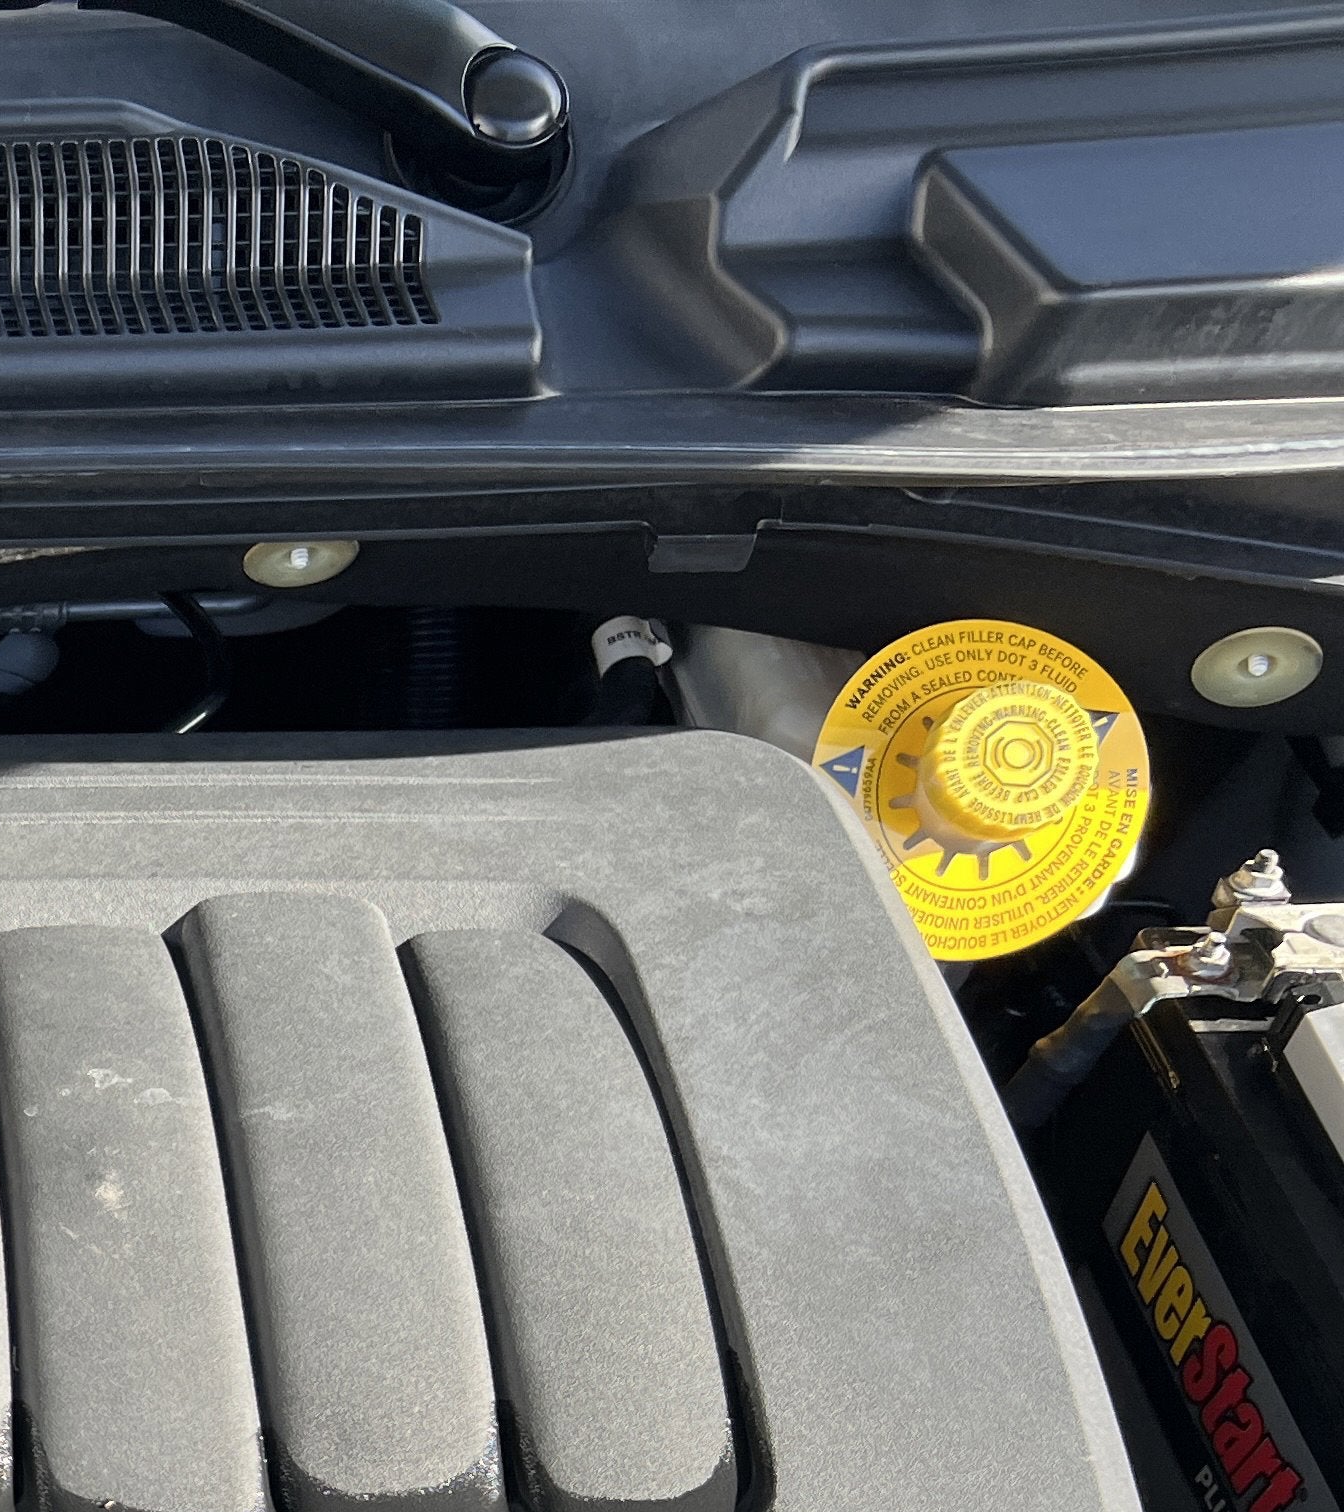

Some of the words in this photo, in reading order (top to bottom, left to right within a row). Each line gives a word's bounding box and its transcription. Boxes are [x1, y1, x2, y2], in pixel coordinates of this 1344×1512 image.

[845, 652, 911, 710] WARNING:
[912, 633, 955, 656] CLEAN
[958, 630, 1004, 645] FILLER
[1008, 634, 1036, 650] CAP
[1039, 643, 1088, 680] BEFORE
[924, 652, 953, 671] USE
[955, 649, 993, 663] ONLY
[997, 650, 1027, 667] DOT
[1028, 659, 1039, 671] 3
[1040, 664, 1078, 693] FLUID
[877, 700, 912, 736] FROM
[910, 691, 922, 704] A
[921, 670, 972, 695] SEALED
[1104, 770, 1121, 818] AVANT
[1124, 768, 1138, 809] MISE
[1084, 804, 1095, 813] 3
[1095, 820, 1112, 840] DE
[1117, 812, 1133, 835] EN
[1030, 816, 1092, 891] PROVENANT
[1084, 841, 1101, 859] LE
[904, 882, 986, 911] CONTENANT
[992, 885, 1027, 907] D'UN
[973, 901, 1034, 929] UTILISER
[1012, 892, 1080, 939] NETTOYER
[991, 930, 1008, 946] LE
